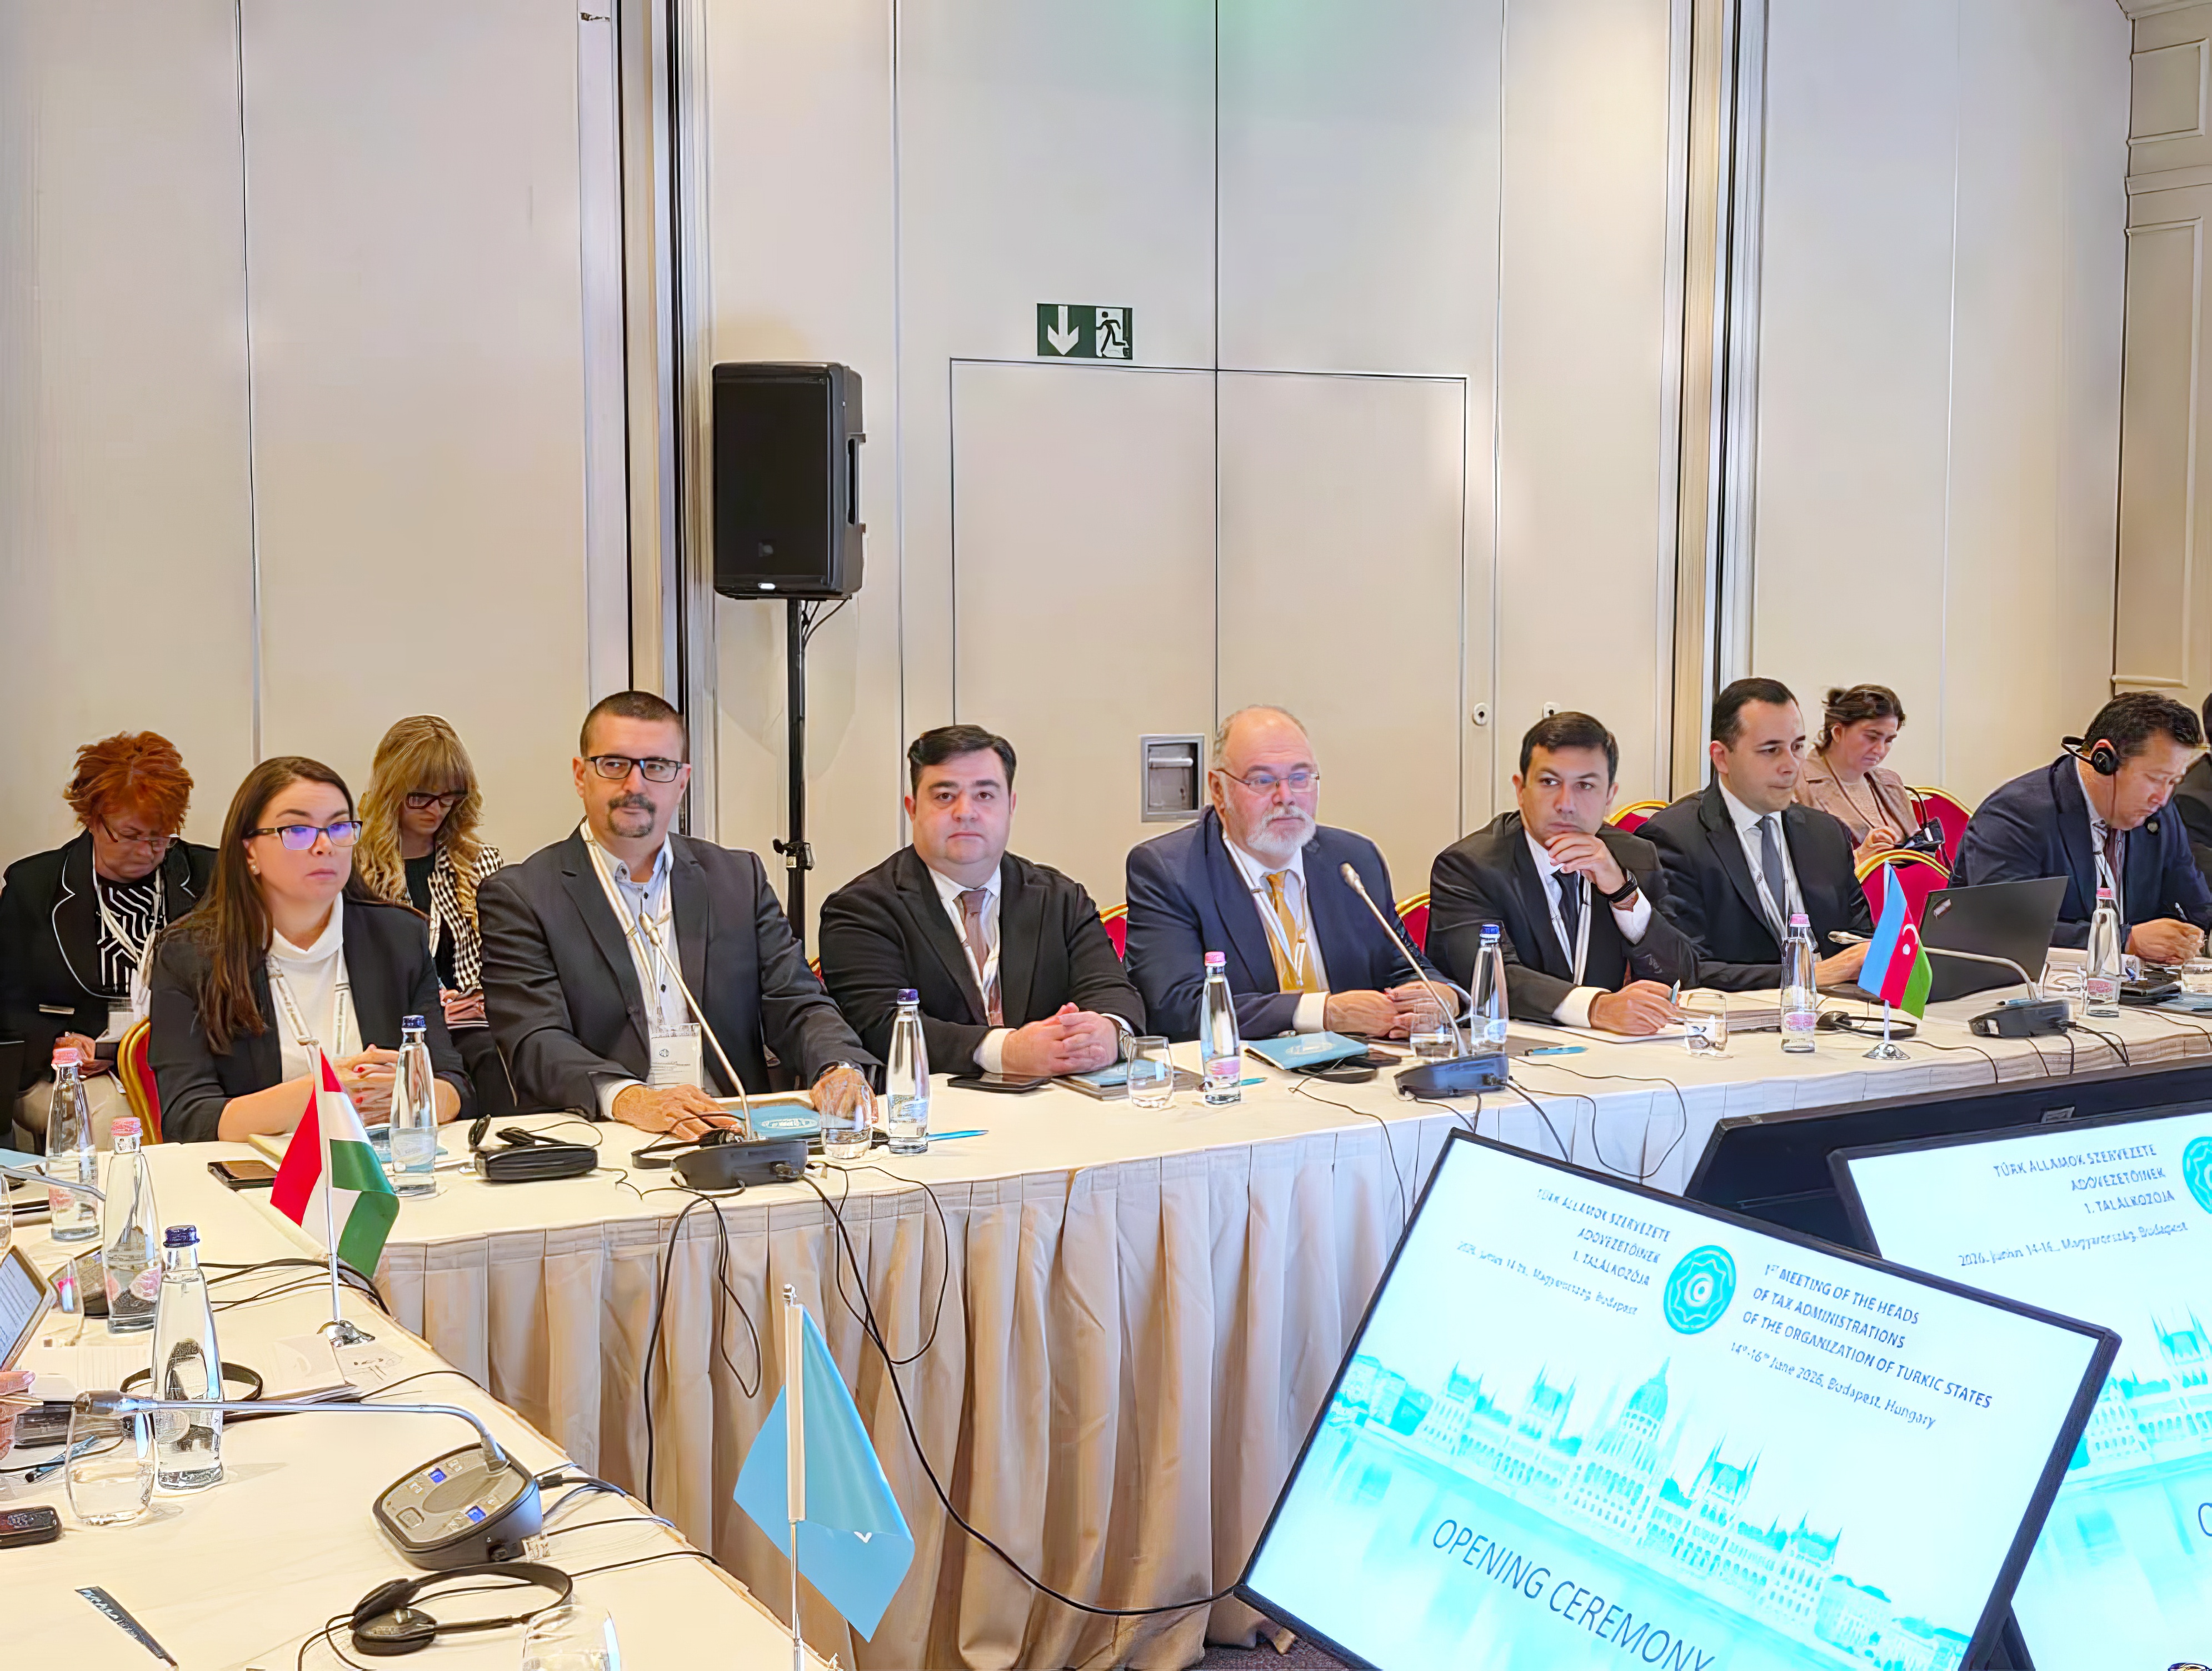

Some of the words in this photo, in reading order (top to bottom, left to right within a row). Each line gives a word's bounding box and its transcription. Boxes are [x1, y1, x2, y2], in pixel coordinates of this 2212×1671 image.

[1753, 1288, 1770, 1301] OF
[1771, 1292, 1794, 1310] TAX
[1794, 1301, 1905, 1348] ADMINISTRATIONS
[1779, 1269, 1831, 1295] MEETING
[1833, 1287, 1850, 1300] OF
[1853, 1292, 1876, 1310] THE
[1877, 1300, 1919, 1324] HEADS
[1742, 1311, 1760, 1324] OF
[1761, 1317, 1783, 1334] THE
[1785, 1325, 1875, 1367] ORGANIZATION
[1876, 1358, 1895, 1373] OF
[1896, 1364, 1944, 1391] TURKIC
[1944, 1382, 1993, 1408] STATES
[1769, 1357, 1795, 1375] June
[1884, 1399, 1936, 1429] Hungary
[1433, 1519, 1550, 1599] OPENING
[1549, 1580, 1715, 1671] CEREMONY
